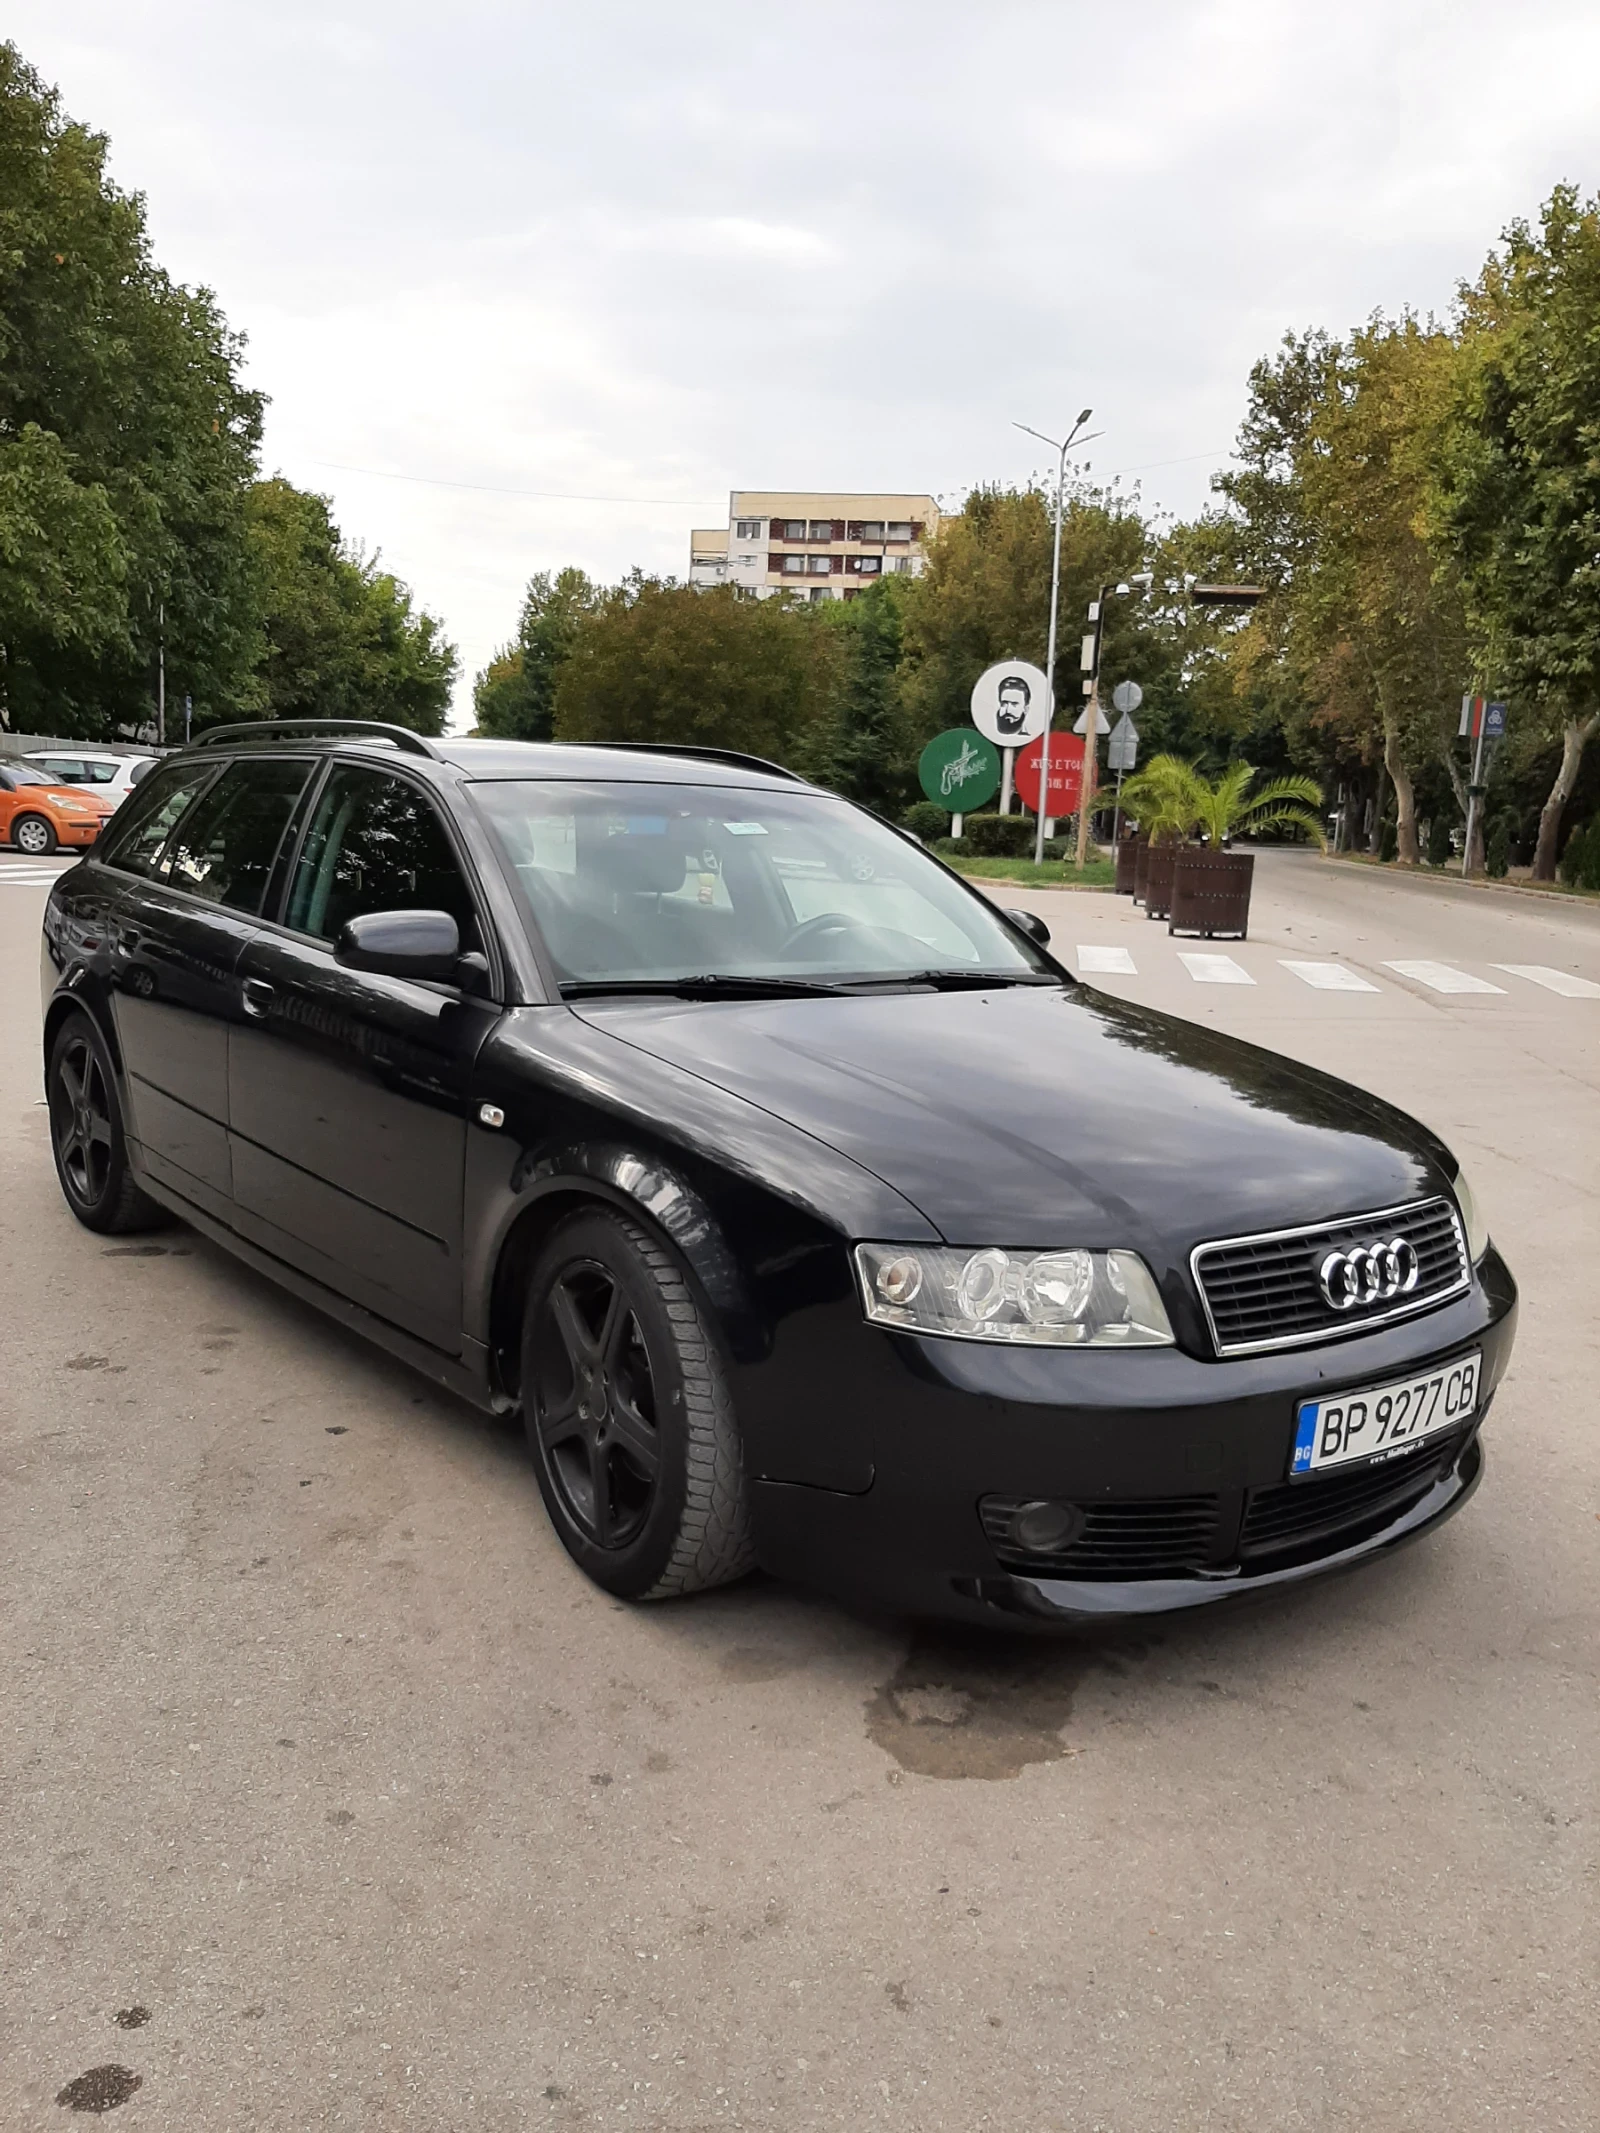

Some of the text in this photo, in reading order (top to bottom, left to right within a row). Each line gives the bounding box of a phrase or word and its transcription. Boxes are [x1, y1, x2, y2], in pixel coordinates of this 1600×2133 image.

[1319, 1364, 1475, 1458] BP 9277 CB
[1294, 1445, 1311, 1461] BG
